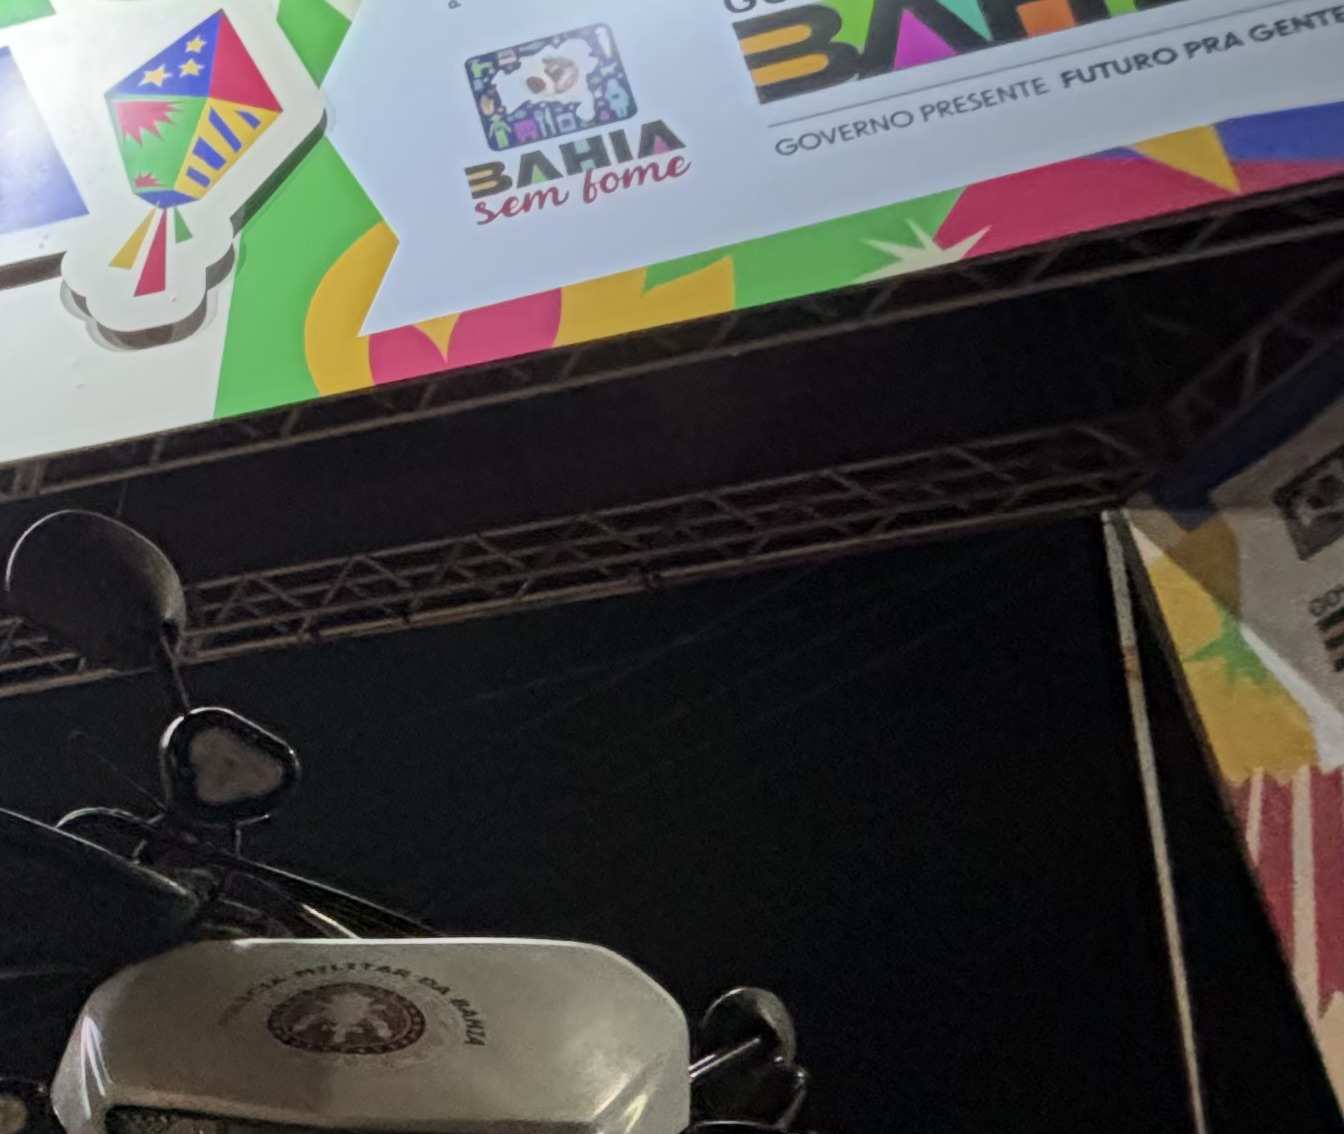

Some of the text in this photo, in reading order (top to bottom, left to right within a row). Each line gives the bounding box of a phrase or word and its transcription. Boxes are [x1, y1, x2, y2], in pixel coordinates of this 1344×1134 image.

[774, 5, 1344, 156] GOVERNO PRESENTE FUTURO PRA GENTE
[464, 119, 687, 200] BAHIA
[474, 155, 692, 226] sem fome
